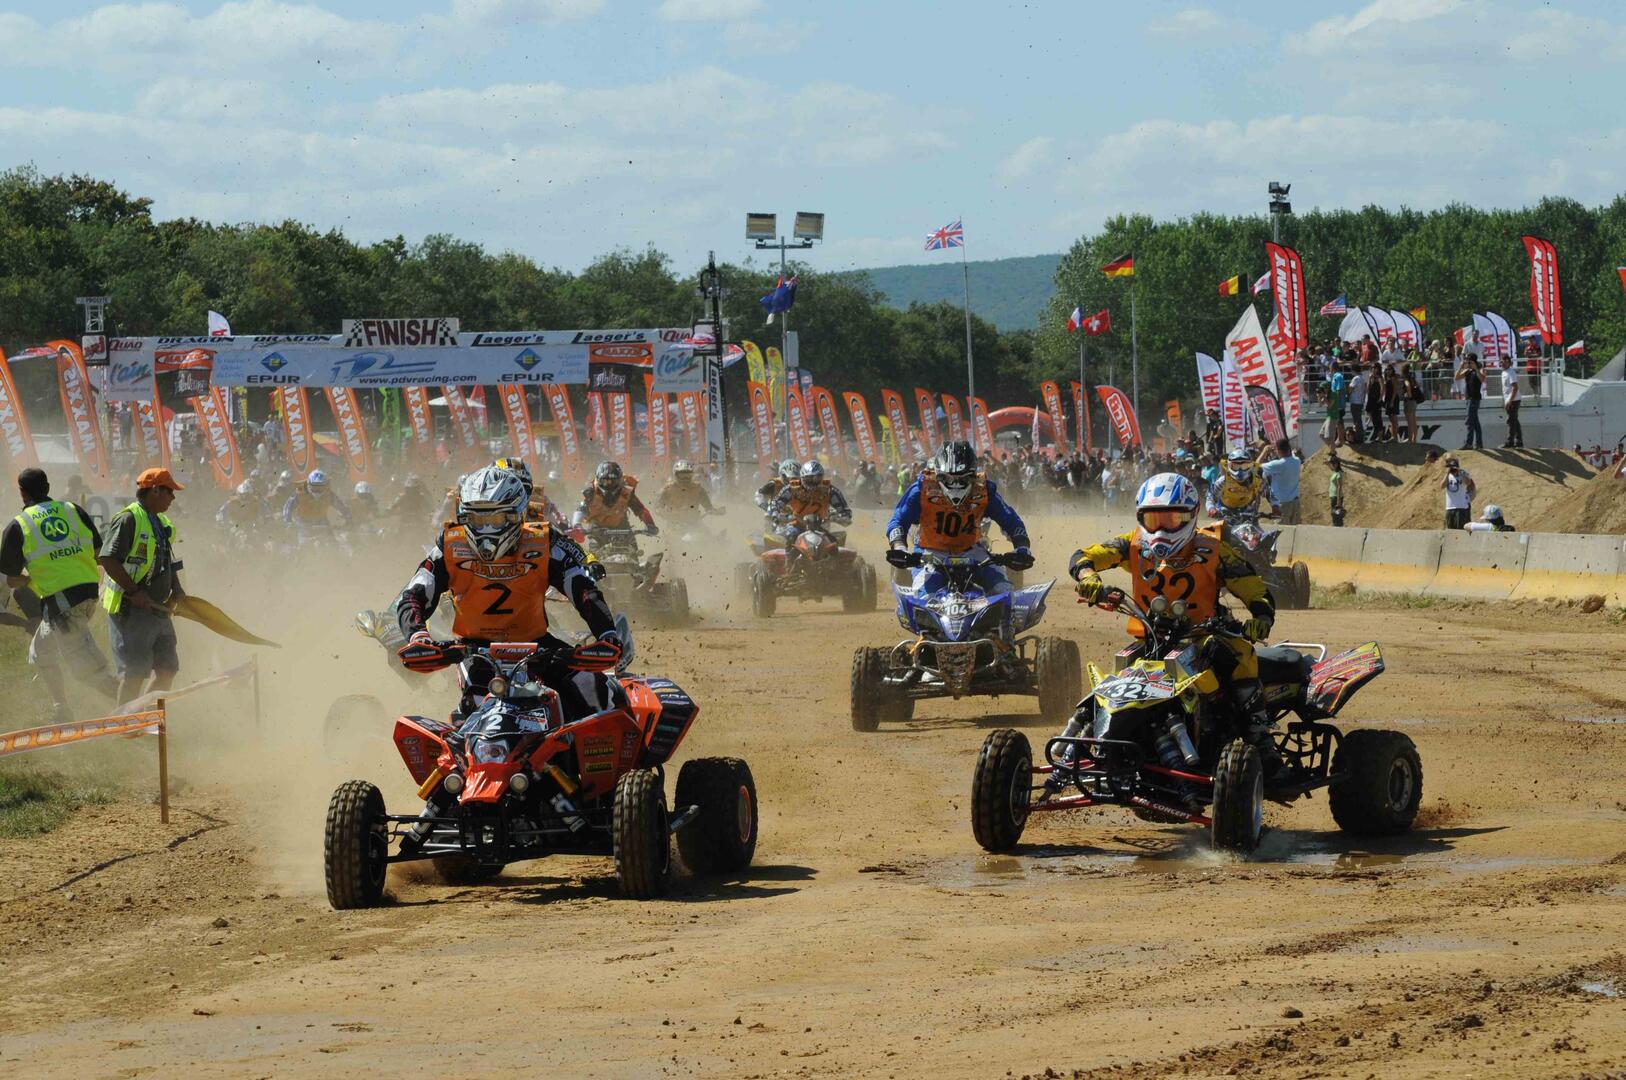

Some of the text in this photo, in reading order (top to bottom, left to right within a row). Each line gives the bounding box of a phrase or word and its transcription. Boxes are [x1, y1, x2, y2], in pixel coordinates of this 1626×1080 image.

[363, 319, 439, 345] FINISH
[570, 331, 646, 344] Laeger's
[157, 335, 236, 344] DRAGON
[253, 335, 332, 343] DRAGON
[471, 333, 546, 346] Laeger's
[246, 375, 301, 384] EPUR
[358, 373, 477, 384] www.pdvracing.com
[501, 373, 554, 382] EPUR
[1225, 371, 1243, 441] YAMAHA
[32, 507, 59, 520] AMPV
[45, 519, 68, 537] 40
[935, 511, 979, 537] 104
[1142, 569, 1197, 609] 32
[482, 583, 513, 615] 2
[944, 604, 968, 616] 104
[1111, 682, 1143, 699] 32
[486, 714, 503, 730] 2
